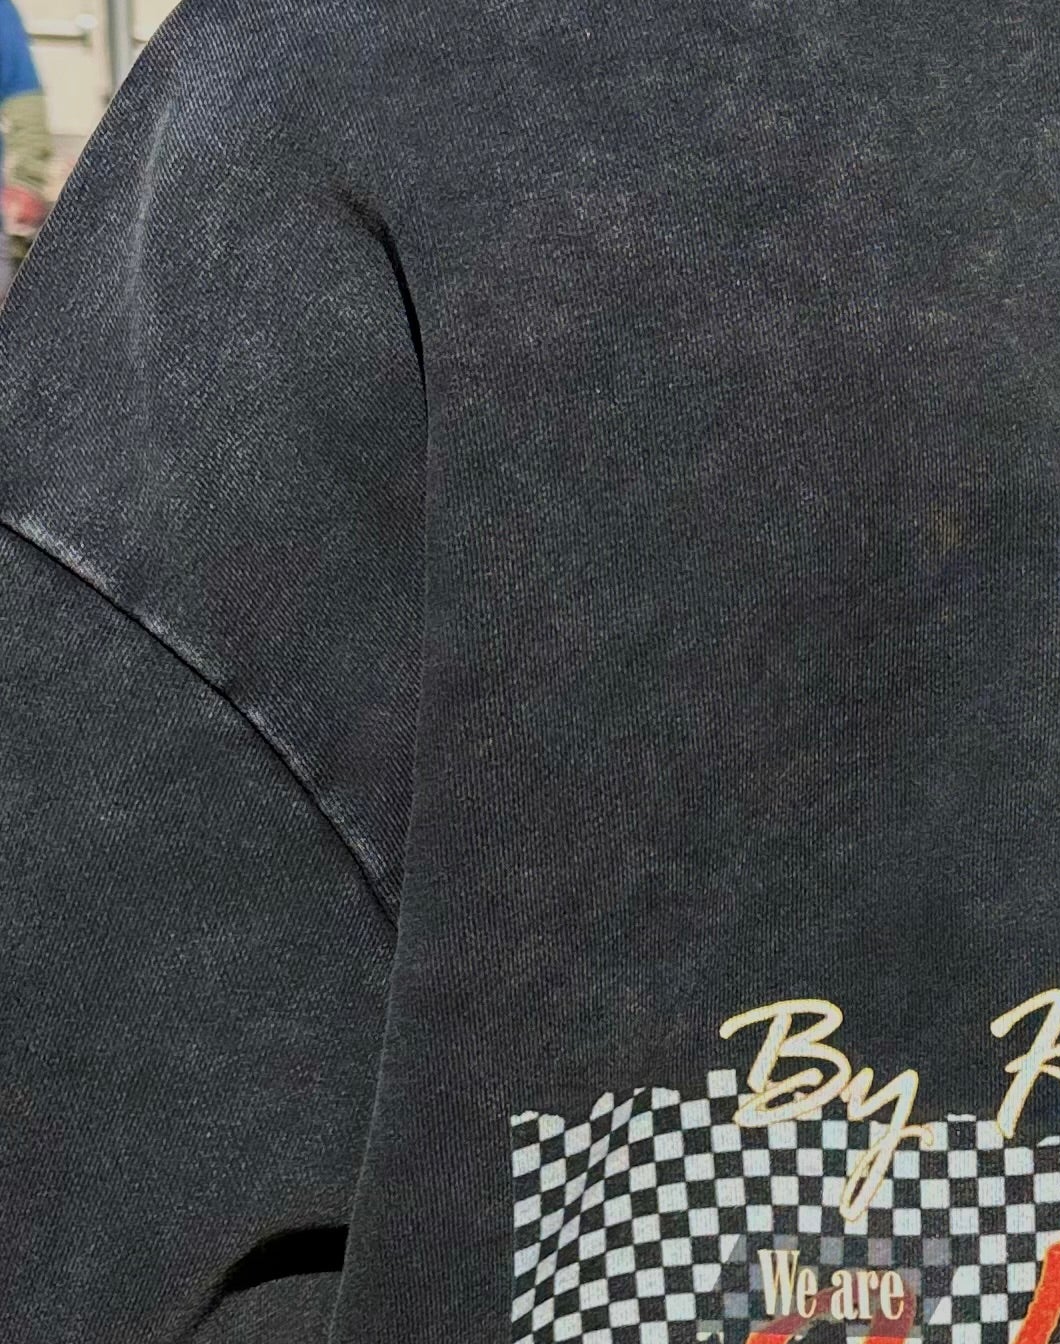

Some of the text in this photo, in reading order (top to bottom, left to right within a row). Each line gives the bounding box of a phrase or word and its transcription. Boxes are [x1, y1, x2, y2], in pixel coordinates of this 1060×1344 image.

[719, 998, 934, 1222] By
[757, 1249, 905, 1320] We are
